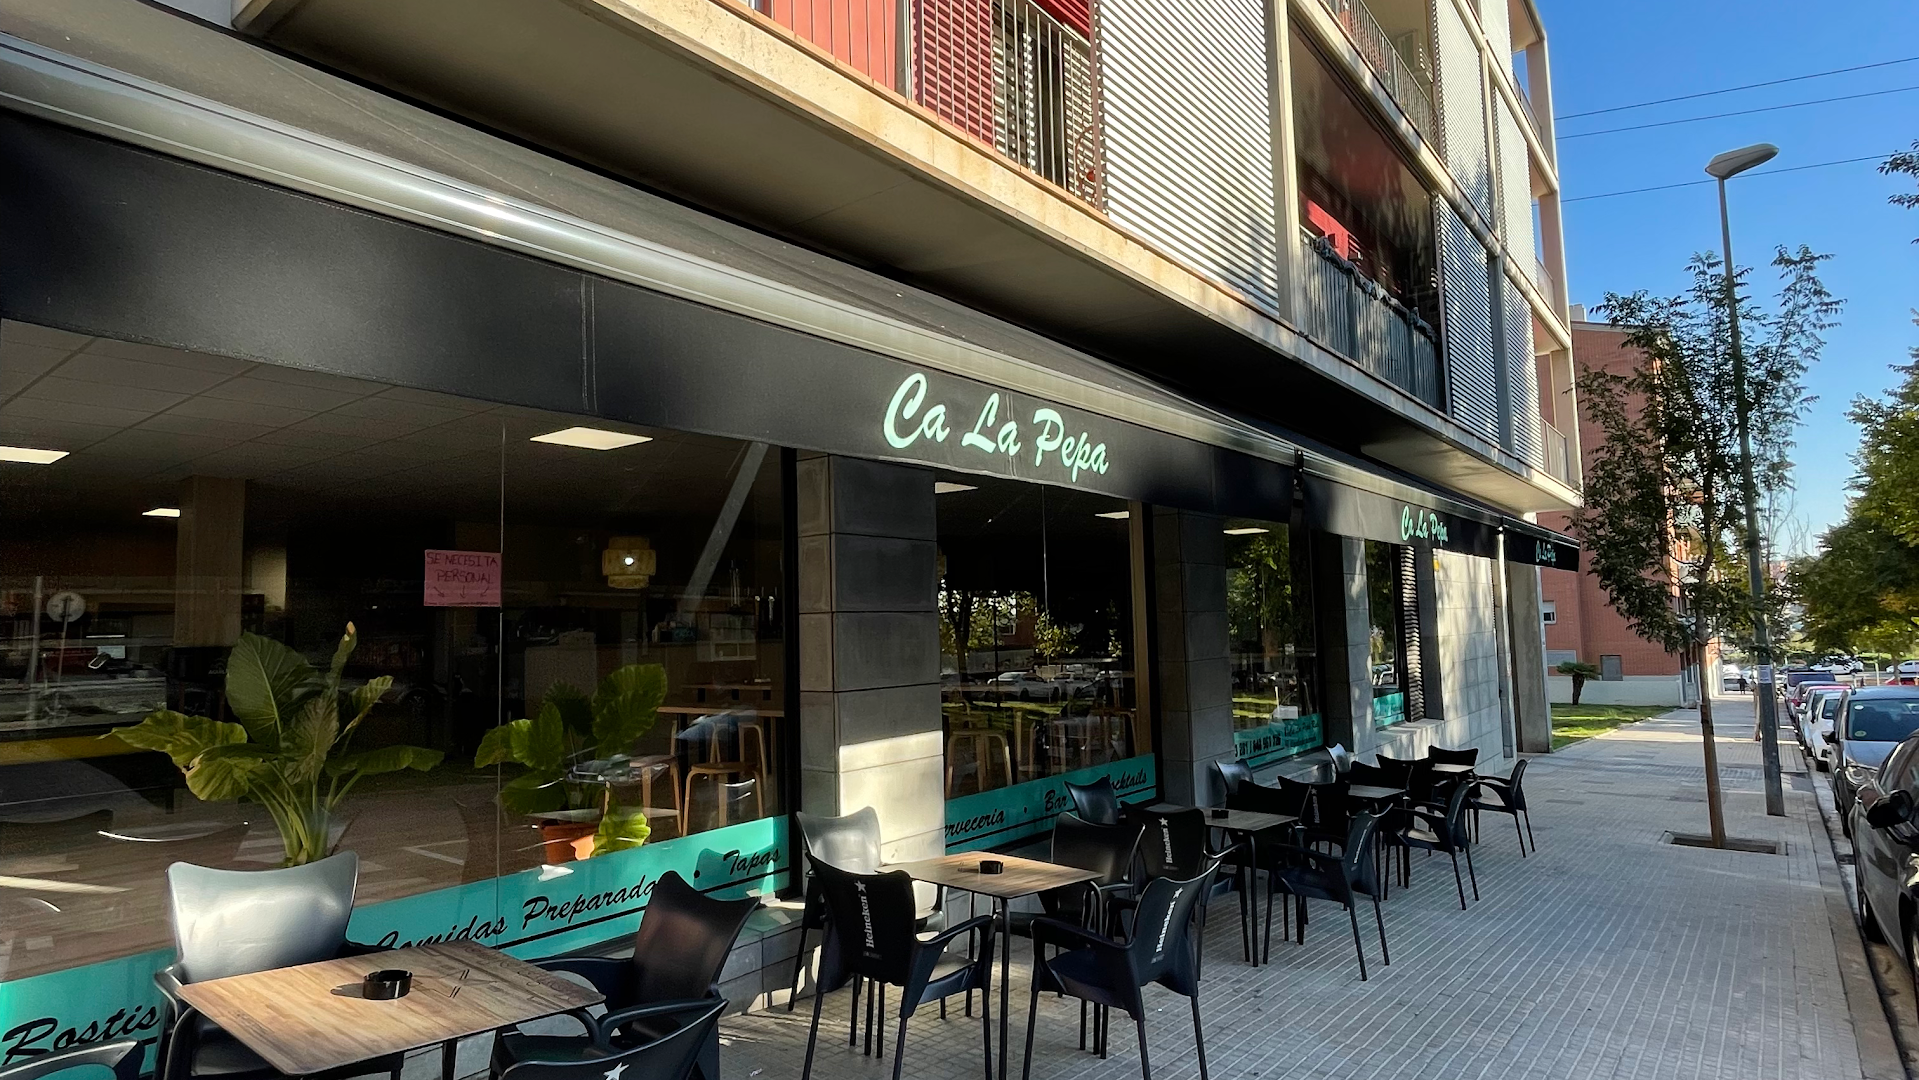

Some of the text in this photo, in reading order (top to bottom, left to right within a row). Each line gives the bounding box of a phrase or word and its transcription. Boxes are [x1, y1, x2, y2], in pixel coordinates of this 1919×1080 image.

[883, 372, 1110, 483] Ca La Pepa
[1401, 505, 1448, 547] Ca La Pepa
[426, 551, 441, 565] SE
[434, 568, 494, 584] PERSONAL
[944, 808, 1005, 839] erveceria
[1044, 788, 1069, 813] Bar
[860, 895, 875, 949] Heineken
[1, 1004, 162, 1066] Rostis
[723, 848, 782, 876] Tapas
